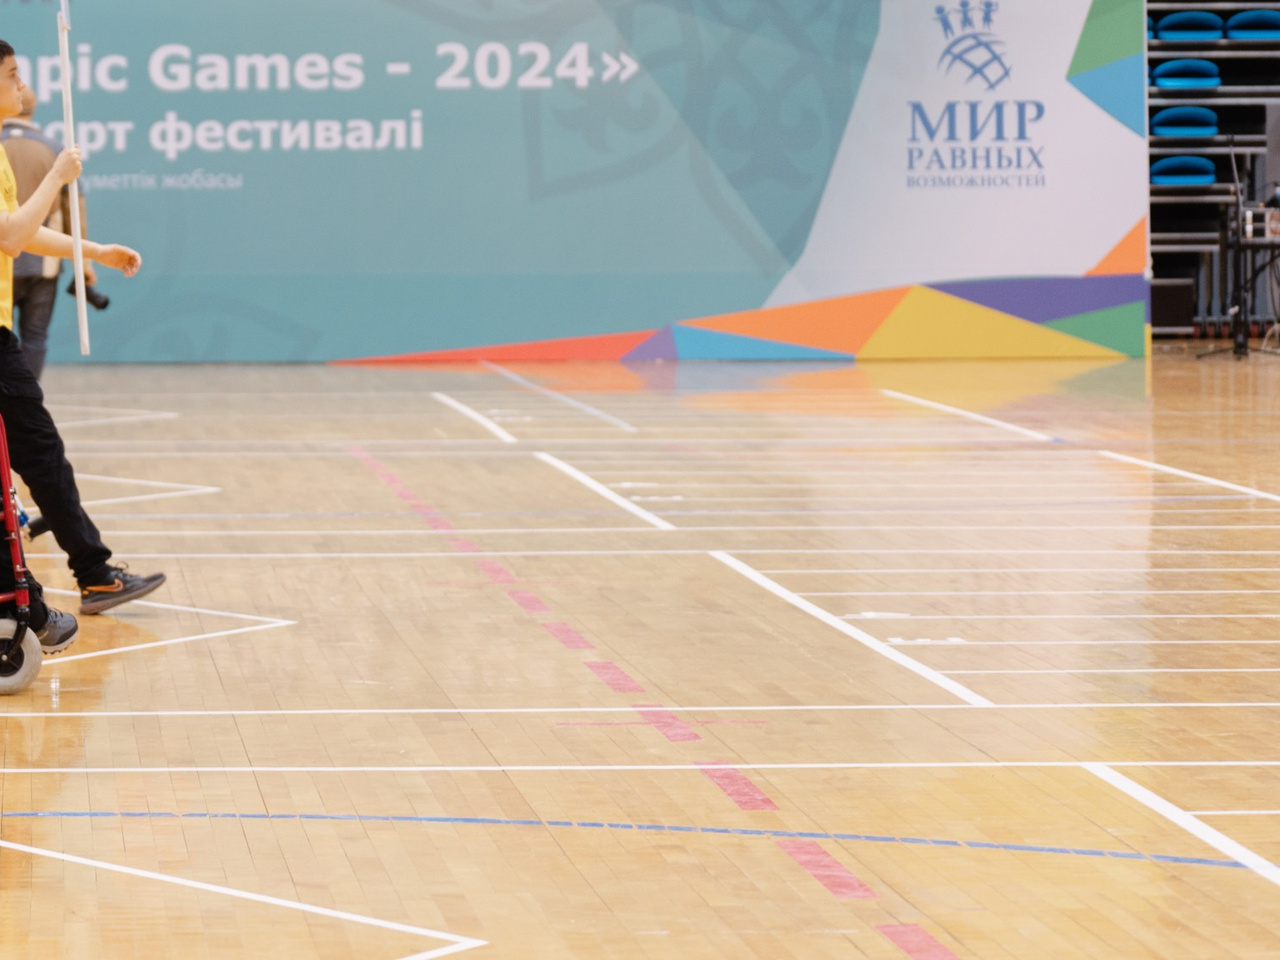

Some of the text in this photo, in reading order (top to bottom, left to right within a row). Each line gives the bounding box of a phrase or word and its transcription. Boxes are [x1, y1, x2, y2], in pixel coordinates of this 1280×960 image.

[147, 42, 366, 93] Games
[434, 41, 640, 91] 2024»
[148, 111, 424, 160] фестивалі
[906, 100, 1046, 143] МИР
[906, 145, 1045, 171] РАВНЫХ
[160, 167, 244, 190] жобасы
[906, 172, 1047, 188] ВОЗМОЖНОСТЕЙ
